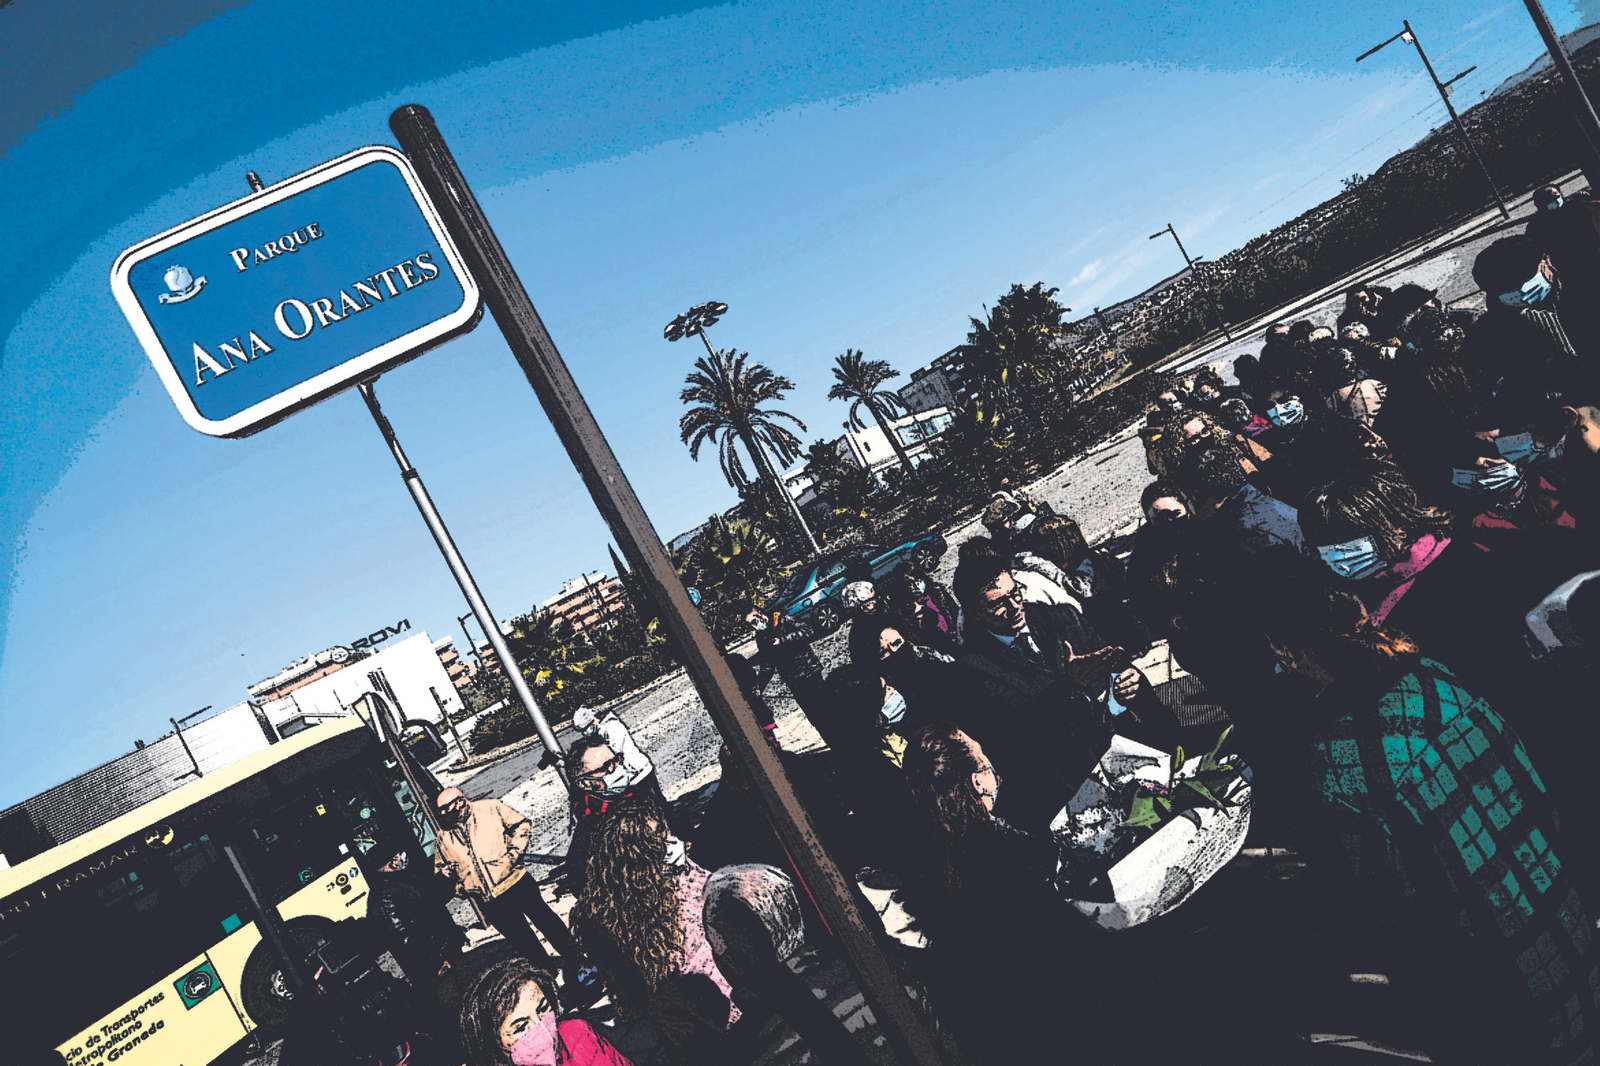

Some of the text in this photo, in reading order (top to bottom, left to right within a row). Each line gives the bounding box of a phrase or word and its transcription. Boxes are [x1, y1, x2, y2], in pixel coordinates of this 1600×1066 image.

[229, 222, 324, 273] PARQUE
[193, 252, 440, 386] ANA ORANTES
[351, 619, 412, 652] ROVI
[85, 1035, 101, 1048] de
[100, 992, 165, 1036] Transportes
[107, 1019, 165, 1062] Granada
